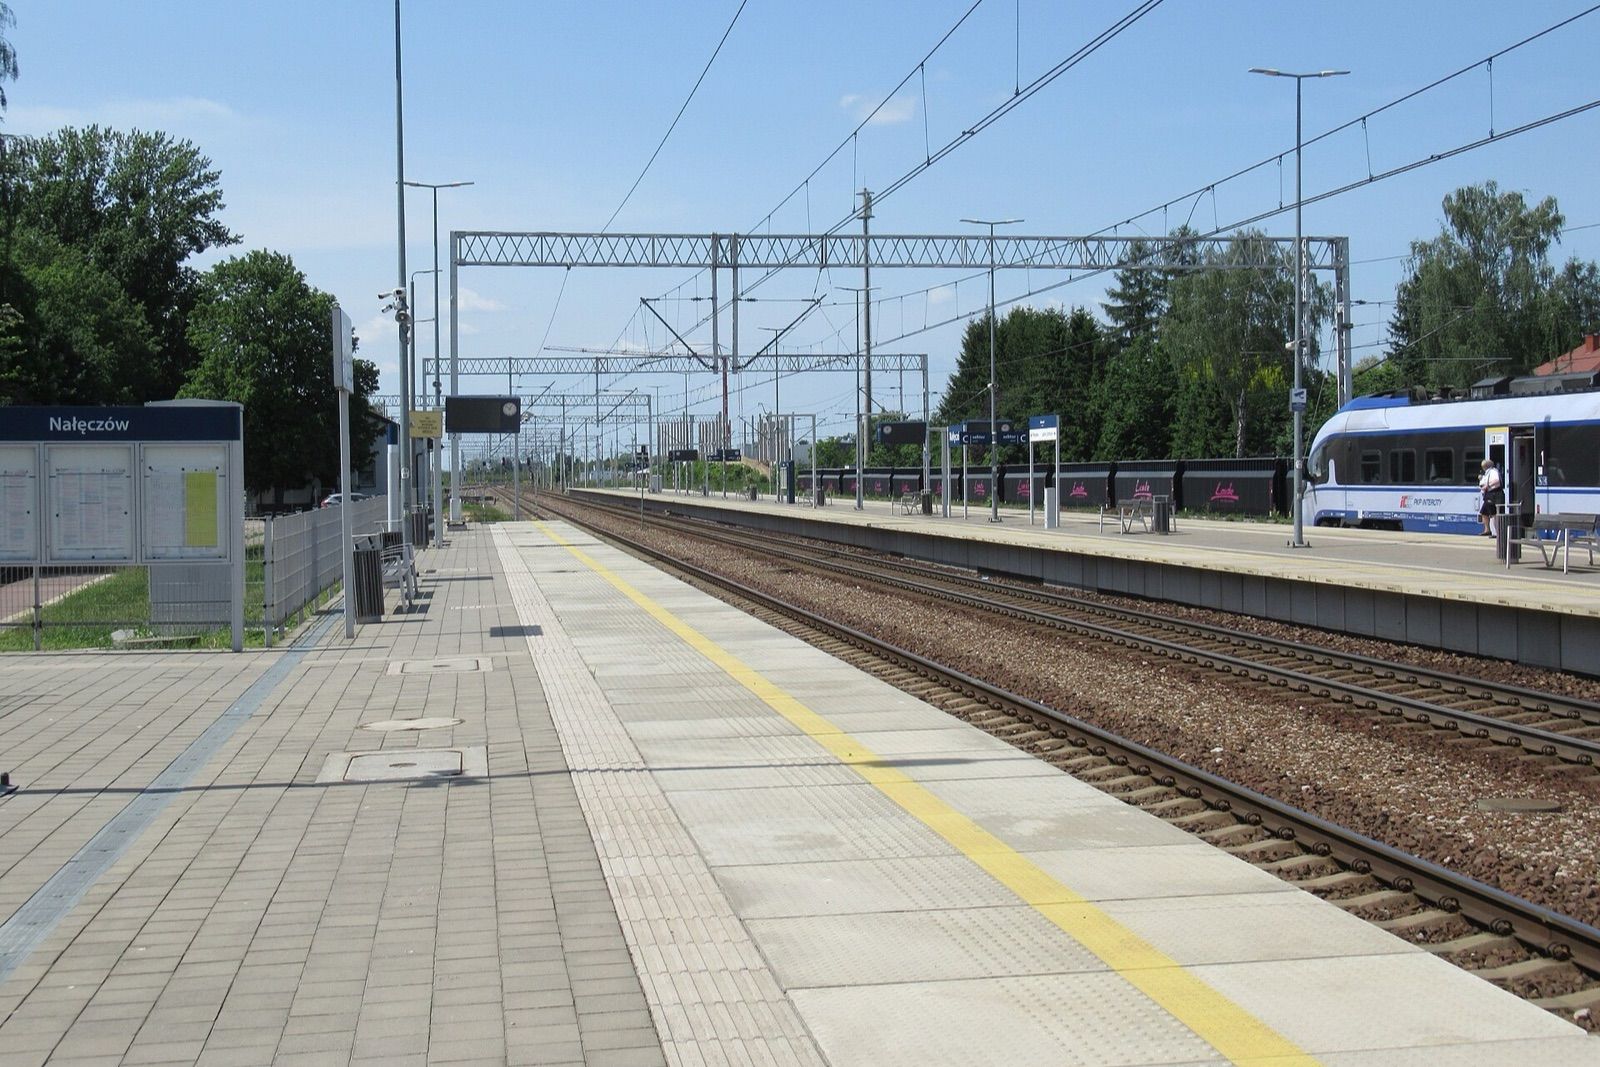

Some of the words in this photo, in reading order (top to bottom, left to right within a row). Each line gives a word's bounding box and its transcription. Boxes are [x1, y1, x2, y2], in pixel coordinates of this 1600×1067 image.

[49, 416, 129, 435] Nałęczów
[962, 434, 969, 444] C
[1020, 434, 1026, 443] C
